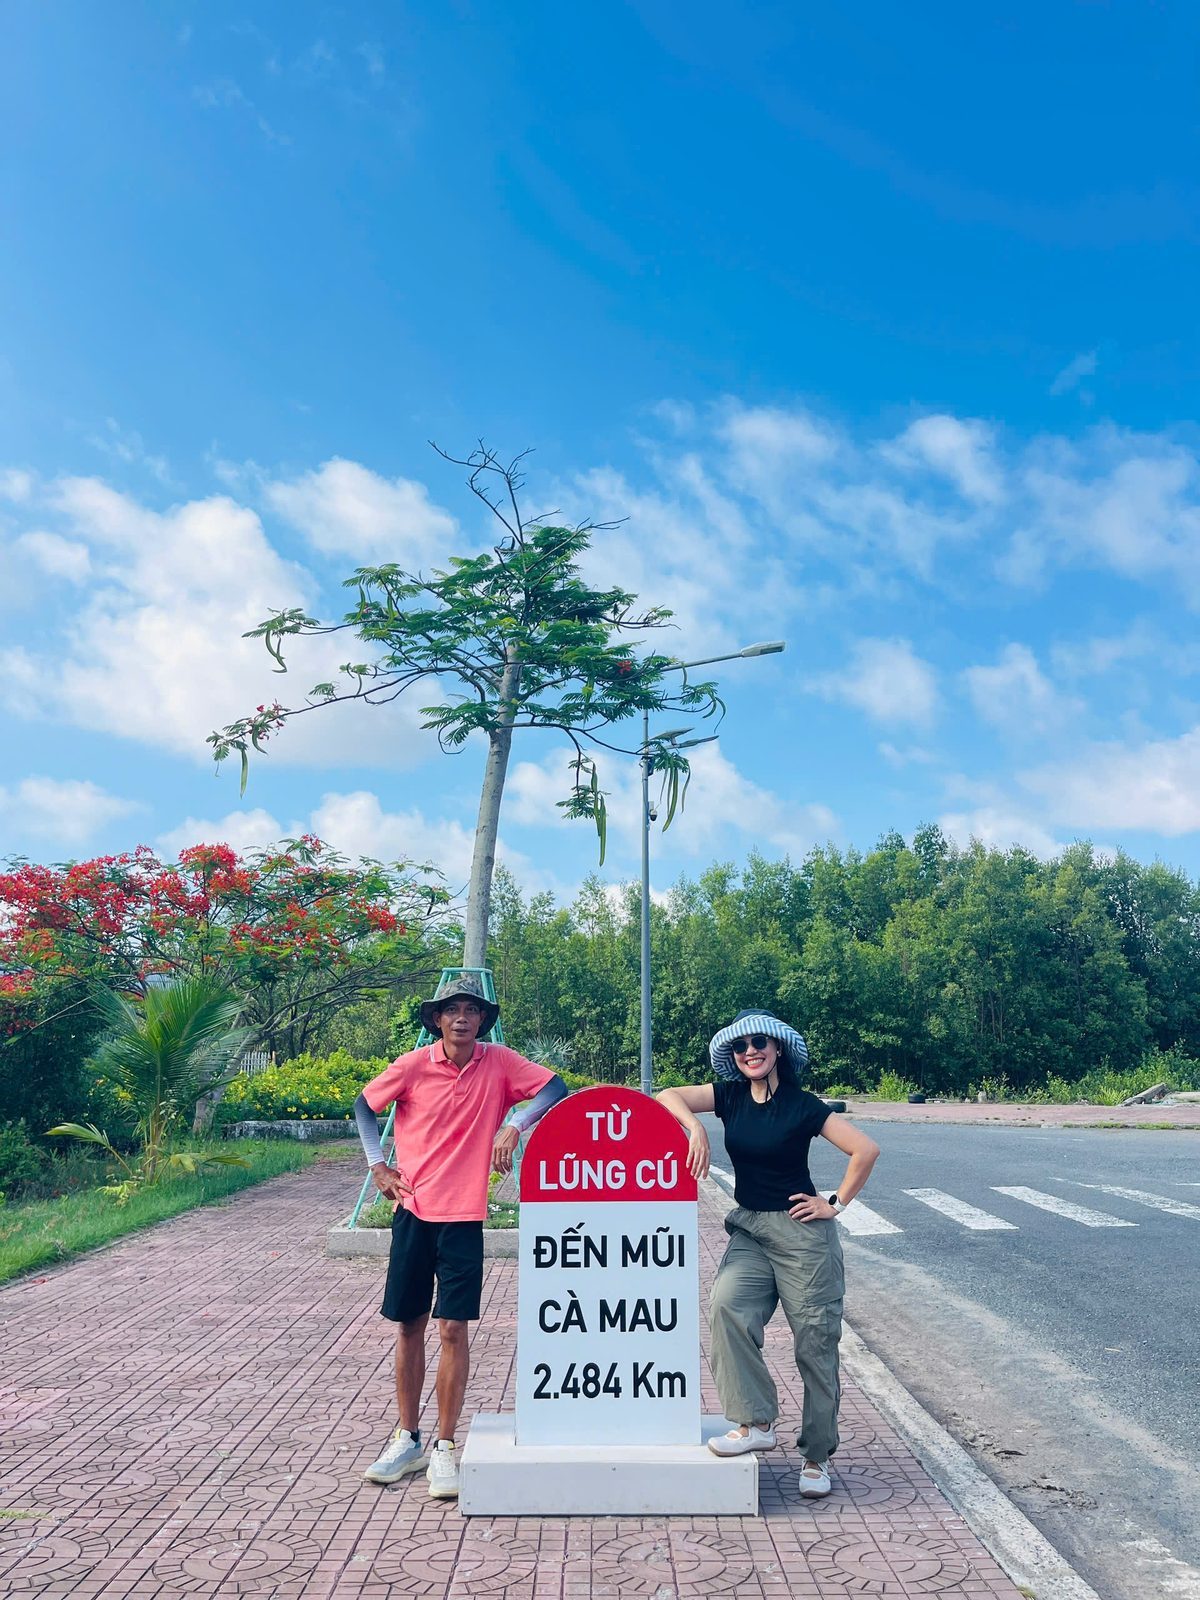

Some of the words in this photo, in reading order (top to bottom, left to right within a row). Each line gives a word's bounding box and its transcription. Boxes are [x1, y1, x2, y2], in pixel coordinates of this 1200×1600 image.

[585, 1103, 632, 1141] TỪ
[539, 1152, 626, 1190] LŨNG
[635, 1151, 678, 1190] CÚ
[532, 1222, 608, 1269] ĐẾN
[621, 1226, 685, 1268] MŨI
[538, 1289, 588, 1334] CÀ
[599, 1298, 678, 1333] MAU
[533, 1362, 622, 1400] 2.484
[632, 1361, 687, 1399] Km
